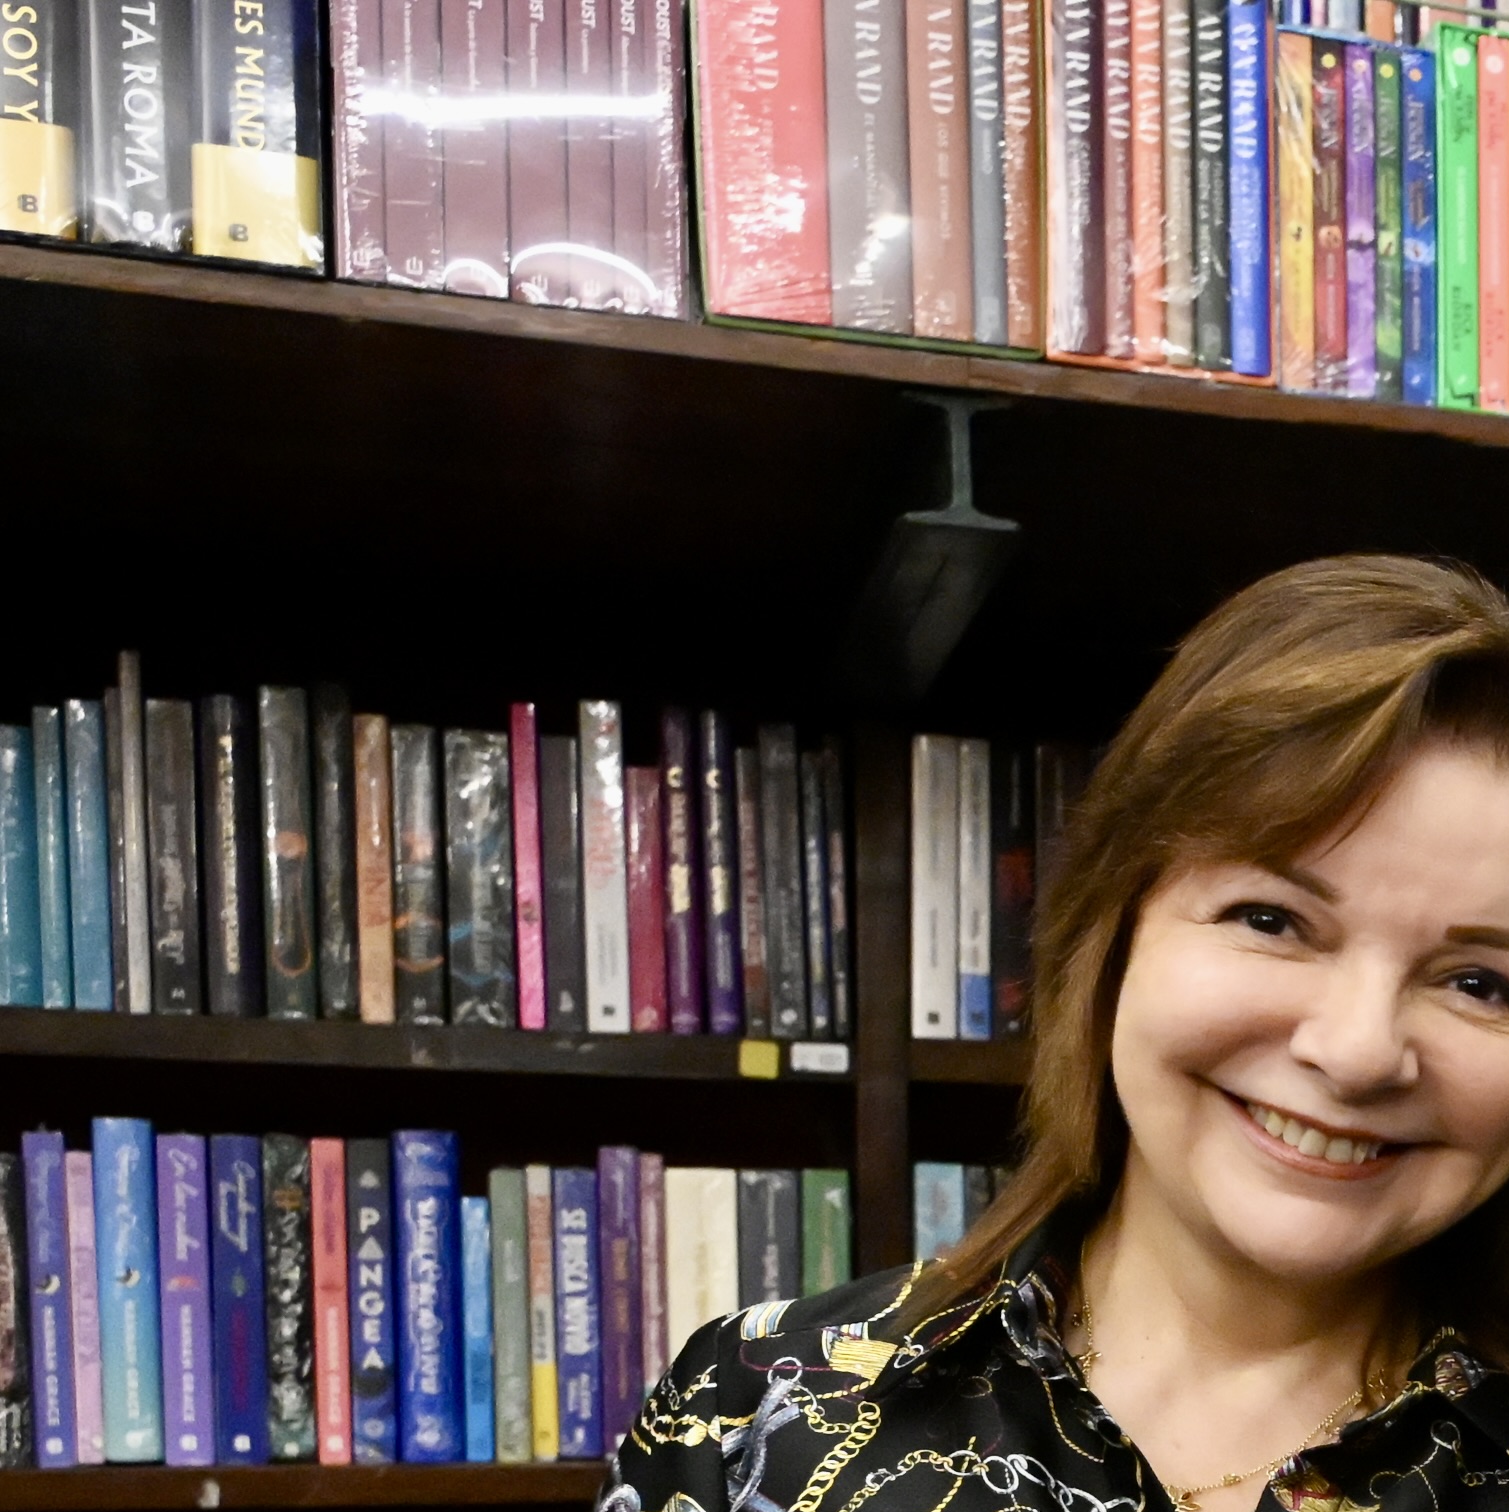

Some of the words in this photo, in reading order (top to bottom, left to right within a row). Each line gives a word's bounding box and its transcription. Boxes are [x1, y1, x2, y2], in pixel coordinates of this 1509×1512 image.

[121, 0, 157, 50] TA
[234, 0, 265, 36] ES
[234, 46, 267, 152] MUND
[854, 22, 882, 105] RAND
[927, 31, 955, 115] RAND
[972, 38, 999, 122] RAND
[1004, 45, 1032, 128] RAND
[1064, 51, 1091, 134] RAND
[1107, 58, 1130, 140] RAND
[1136, 63, 1160, 145] RAND
[3, 102, 40, 124] Y
[122, 62, 160, 189] ROMA
[1167, 69, 1191, 150] RAND
[1198, 72, 1223, 154] RAND
[357, 1206, 386, 1371] PANGEA
